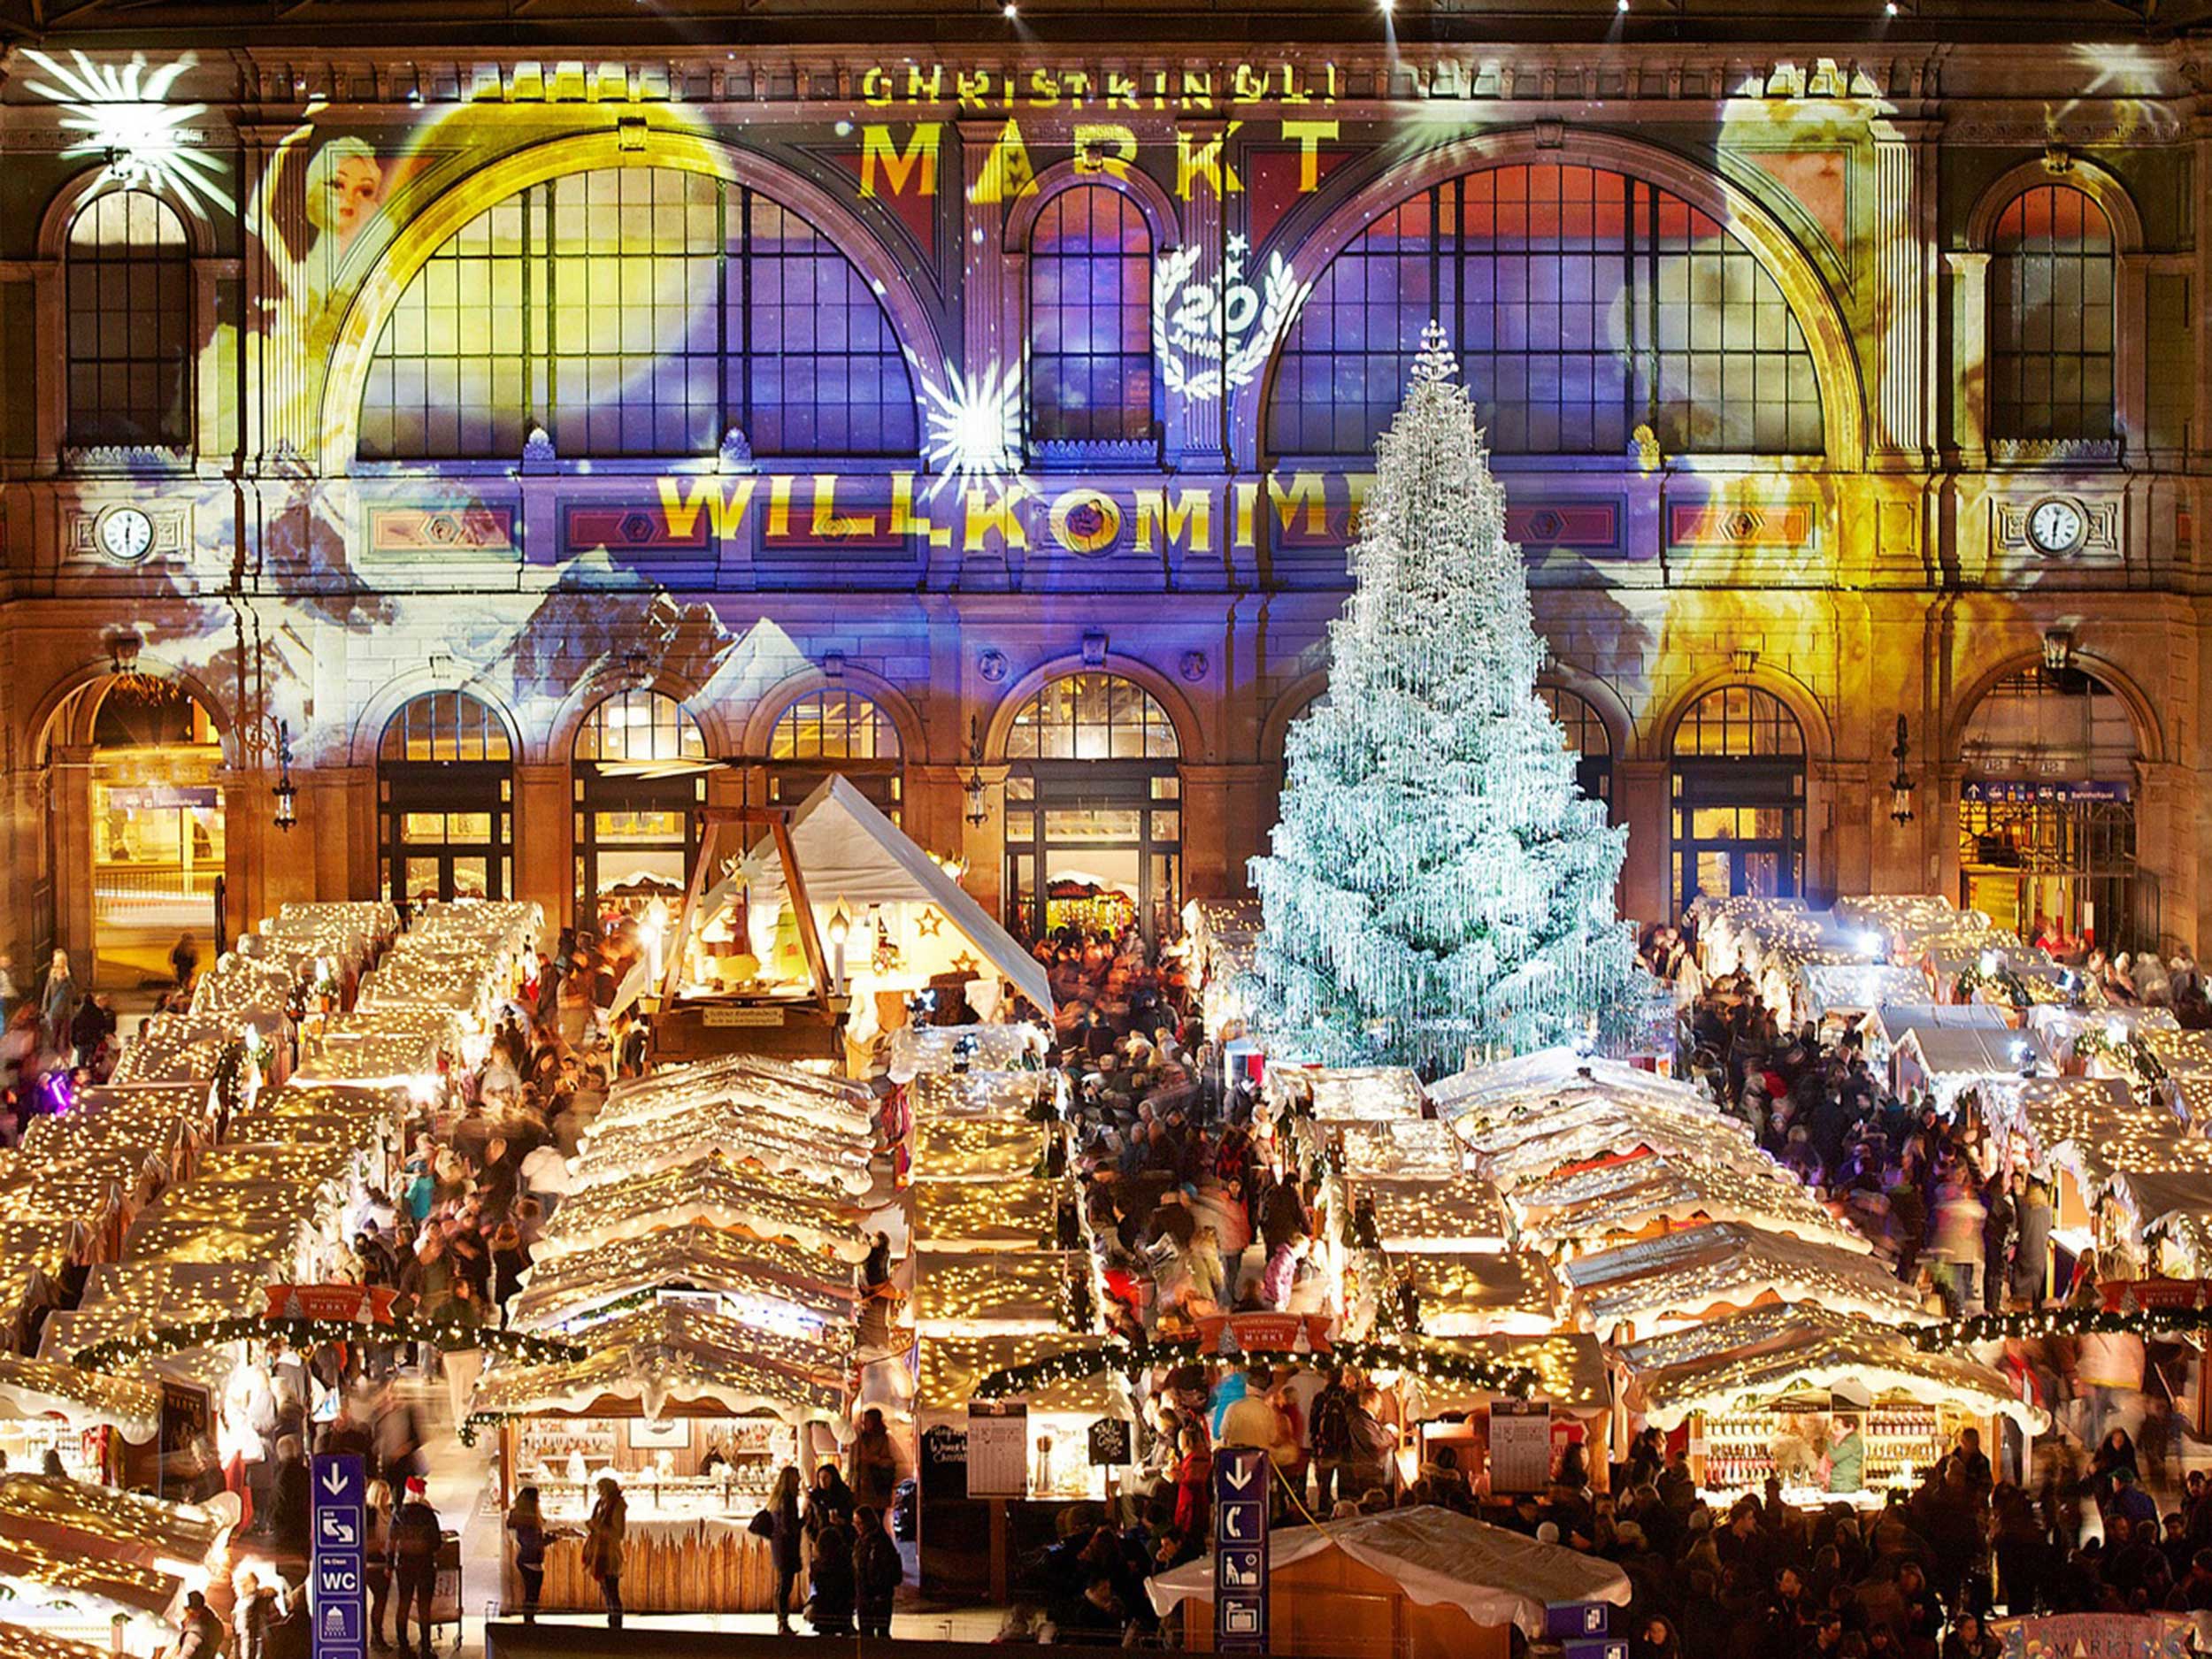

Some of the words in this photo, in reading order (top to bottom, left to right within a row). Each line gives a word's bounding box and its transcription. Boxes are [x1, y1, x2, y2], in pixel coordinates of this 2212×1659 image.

[863, 65, 1335, 110] CHRISTKINDLI
[856, 117, 1340, 204] MARKT
[1172, 284, 1258, 335] 20
[1168, 327, 1241, 361] JAHRE
[322, 1571, 356, 1590] WC
